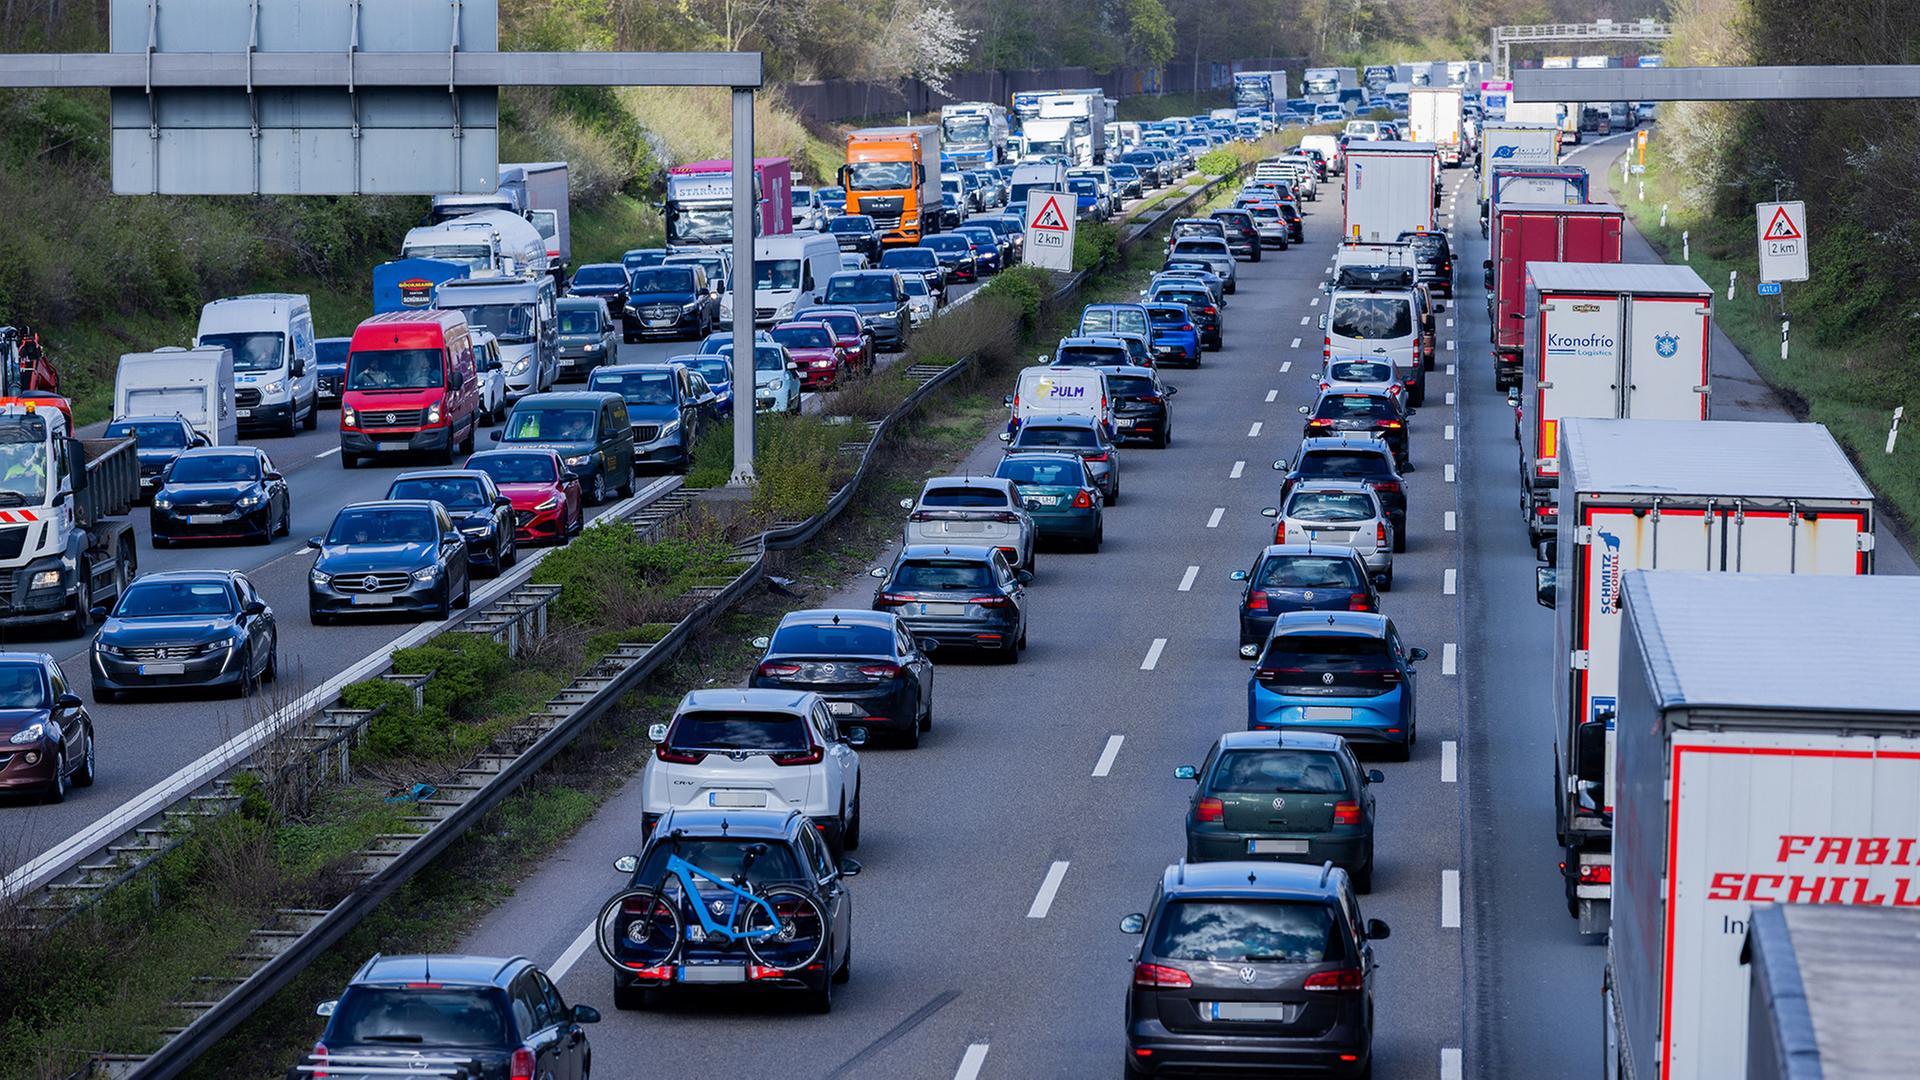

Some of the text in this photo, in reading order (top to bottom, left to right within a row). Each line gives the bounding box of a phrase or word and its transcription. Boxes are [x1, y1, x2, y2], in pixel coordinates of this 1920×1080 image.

[1038, 233, 1060, 244] 2 km
[1772, 243, 1795, 253] 2 km
[1548, 333, 1614, 347] Kronofrío
[1050, 386, 1084, 397] PULM
[1601, 553, 1612, 615] SCHMITZ
[1610, 553, 1620, 615] CARGOBULL
[1777, 835, 1920, 866] FABI
